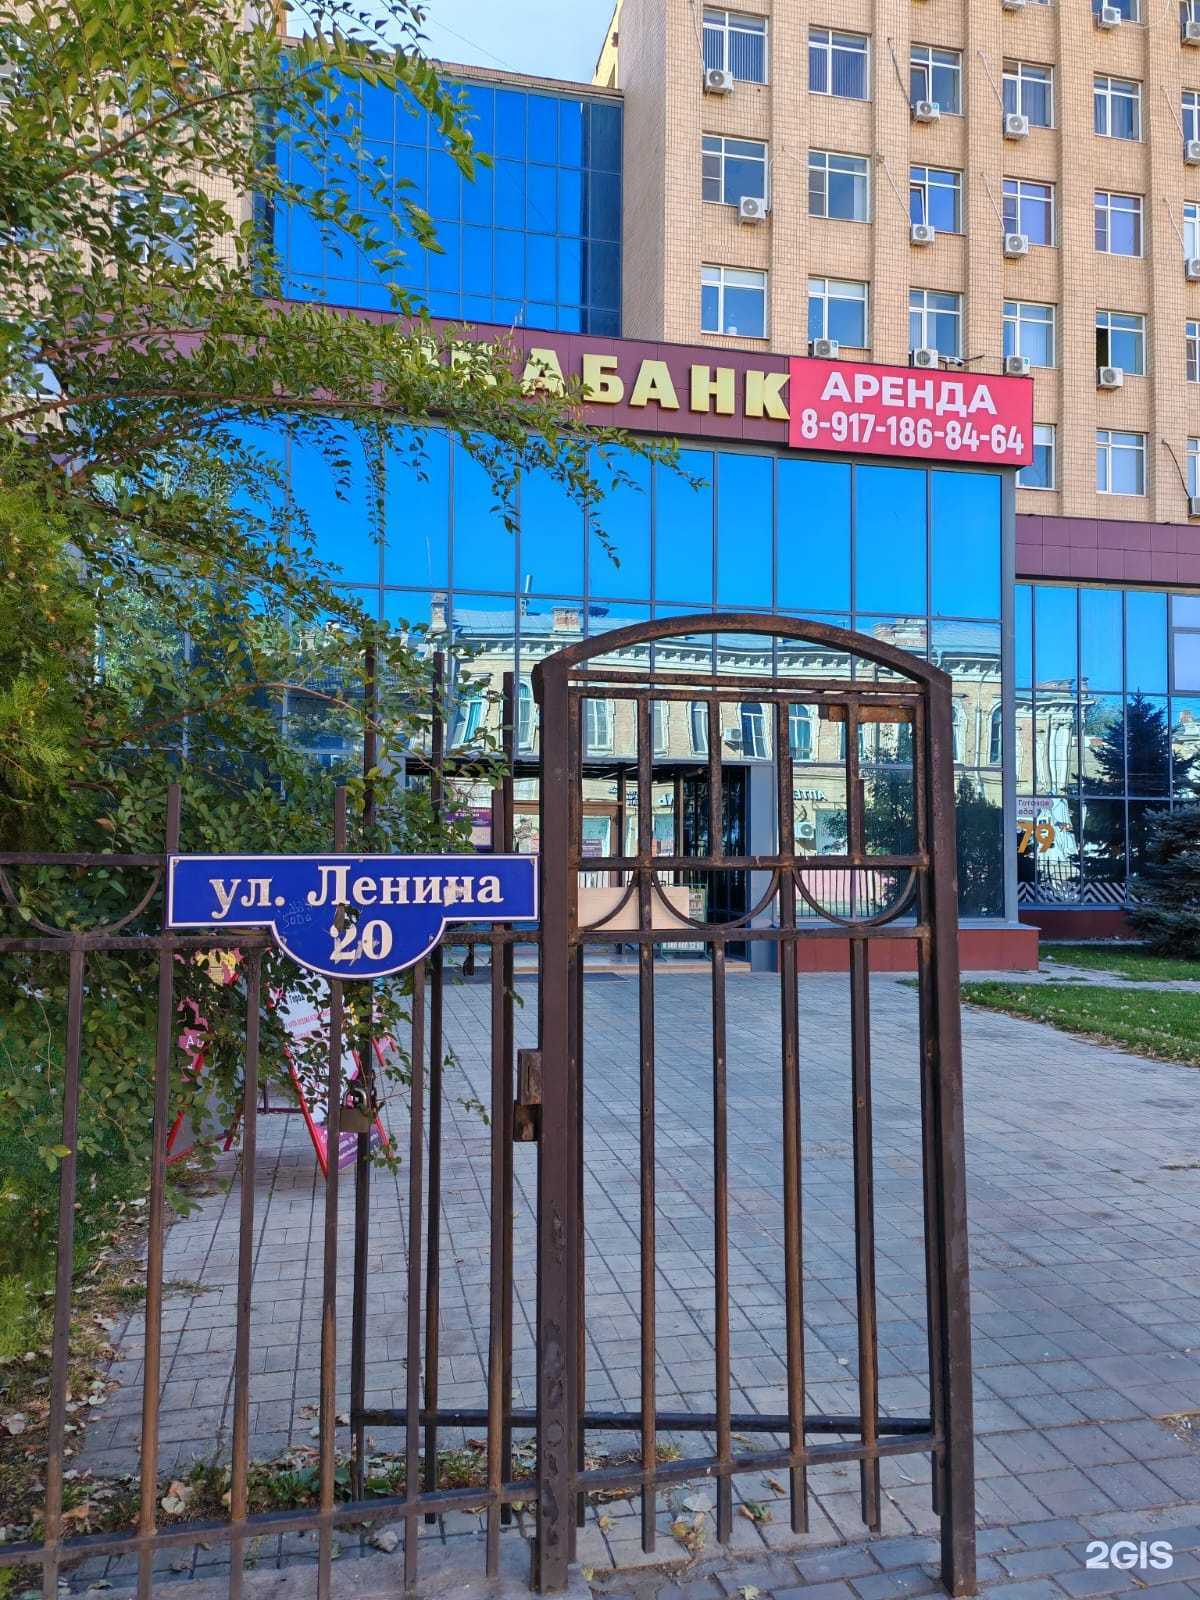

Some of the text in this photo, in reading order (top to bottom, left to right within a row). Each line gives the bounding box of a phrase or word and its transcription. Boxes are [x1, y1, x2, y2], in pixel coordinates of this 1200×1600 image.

[820, 371, 998, 418] АРЕНДА
[801, 408, 1024, 456] 8-917-186-84-64
[1017, 821, 1055, 853] 79
[209, 879, 285, 920] ул.
[307, 865, 504, 907] Ленина
[329, 919, 394, 964] 20
